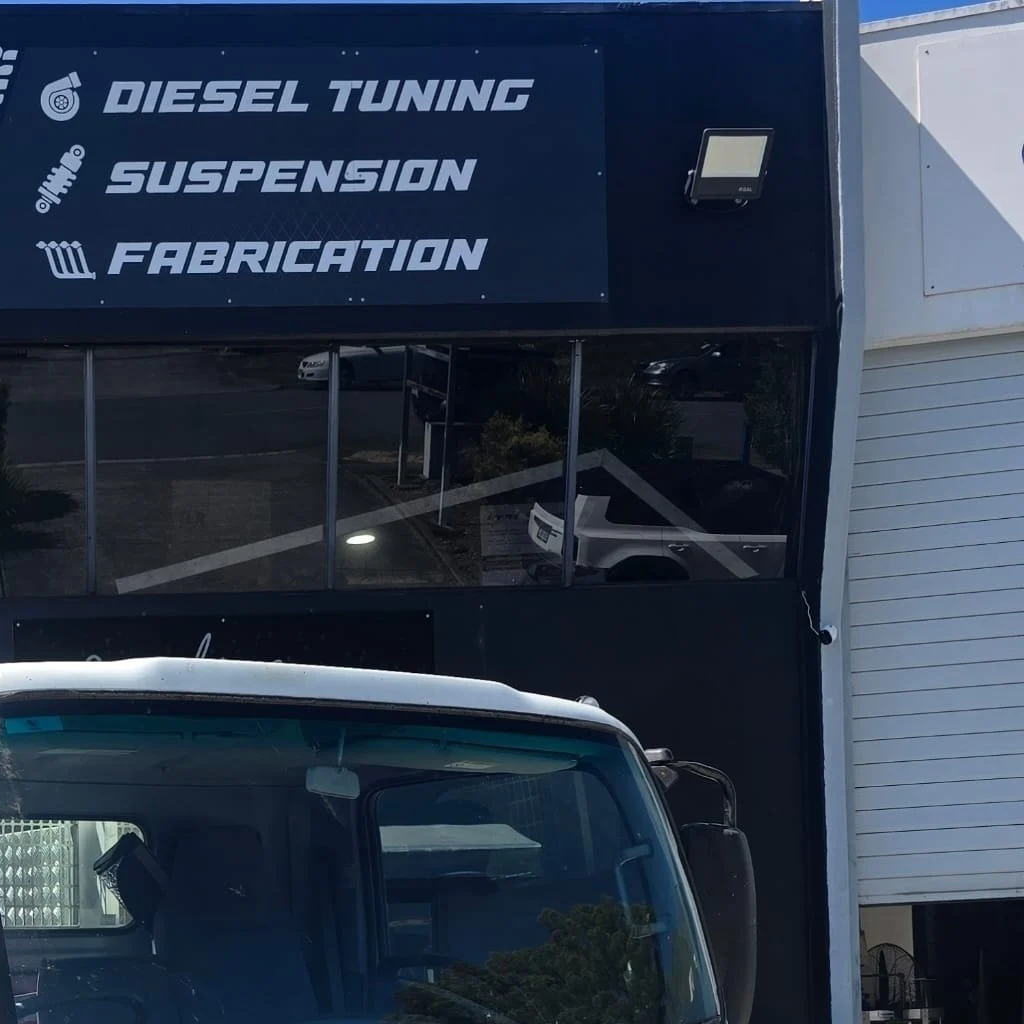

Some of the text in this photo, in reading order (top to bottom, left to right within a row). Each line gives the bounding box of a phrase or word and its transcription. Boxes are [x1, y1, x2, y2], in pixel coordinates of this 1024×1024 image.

[103, 79, 535, 113] DIESEL TUNING
[105, 159, 477, 195] SUSPENSION
[107, 238, 488, 276] FABRICATION
